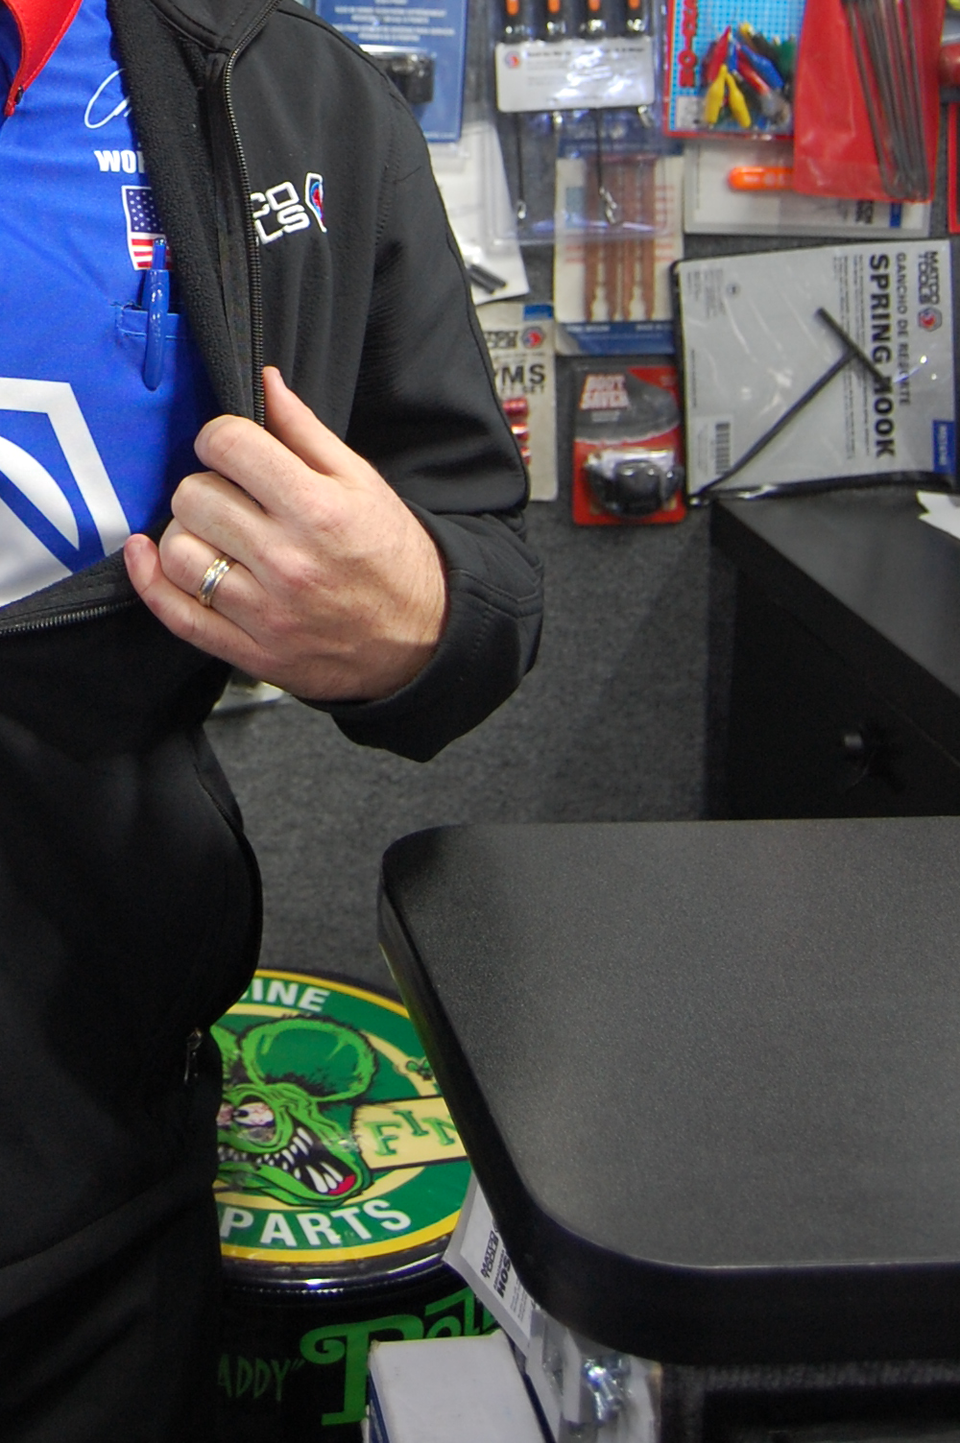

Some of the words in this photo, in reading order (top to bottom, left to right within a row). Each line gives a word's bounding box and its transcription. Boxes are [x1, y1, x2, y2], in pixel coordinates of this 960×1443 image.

[896, 252, 908, 315] GANCHO
[918, 255, 930, 305] TOOLS
[929, 251, 940, 305] MATCO
[869, 254, 893, 365] SPRING
[897, 319, 909, 338] DE
[241, 977, 332, 1012] INE
[220, 1199, 413, 1248] PARTS
[480, 1229, 496, 1276] MATCO
